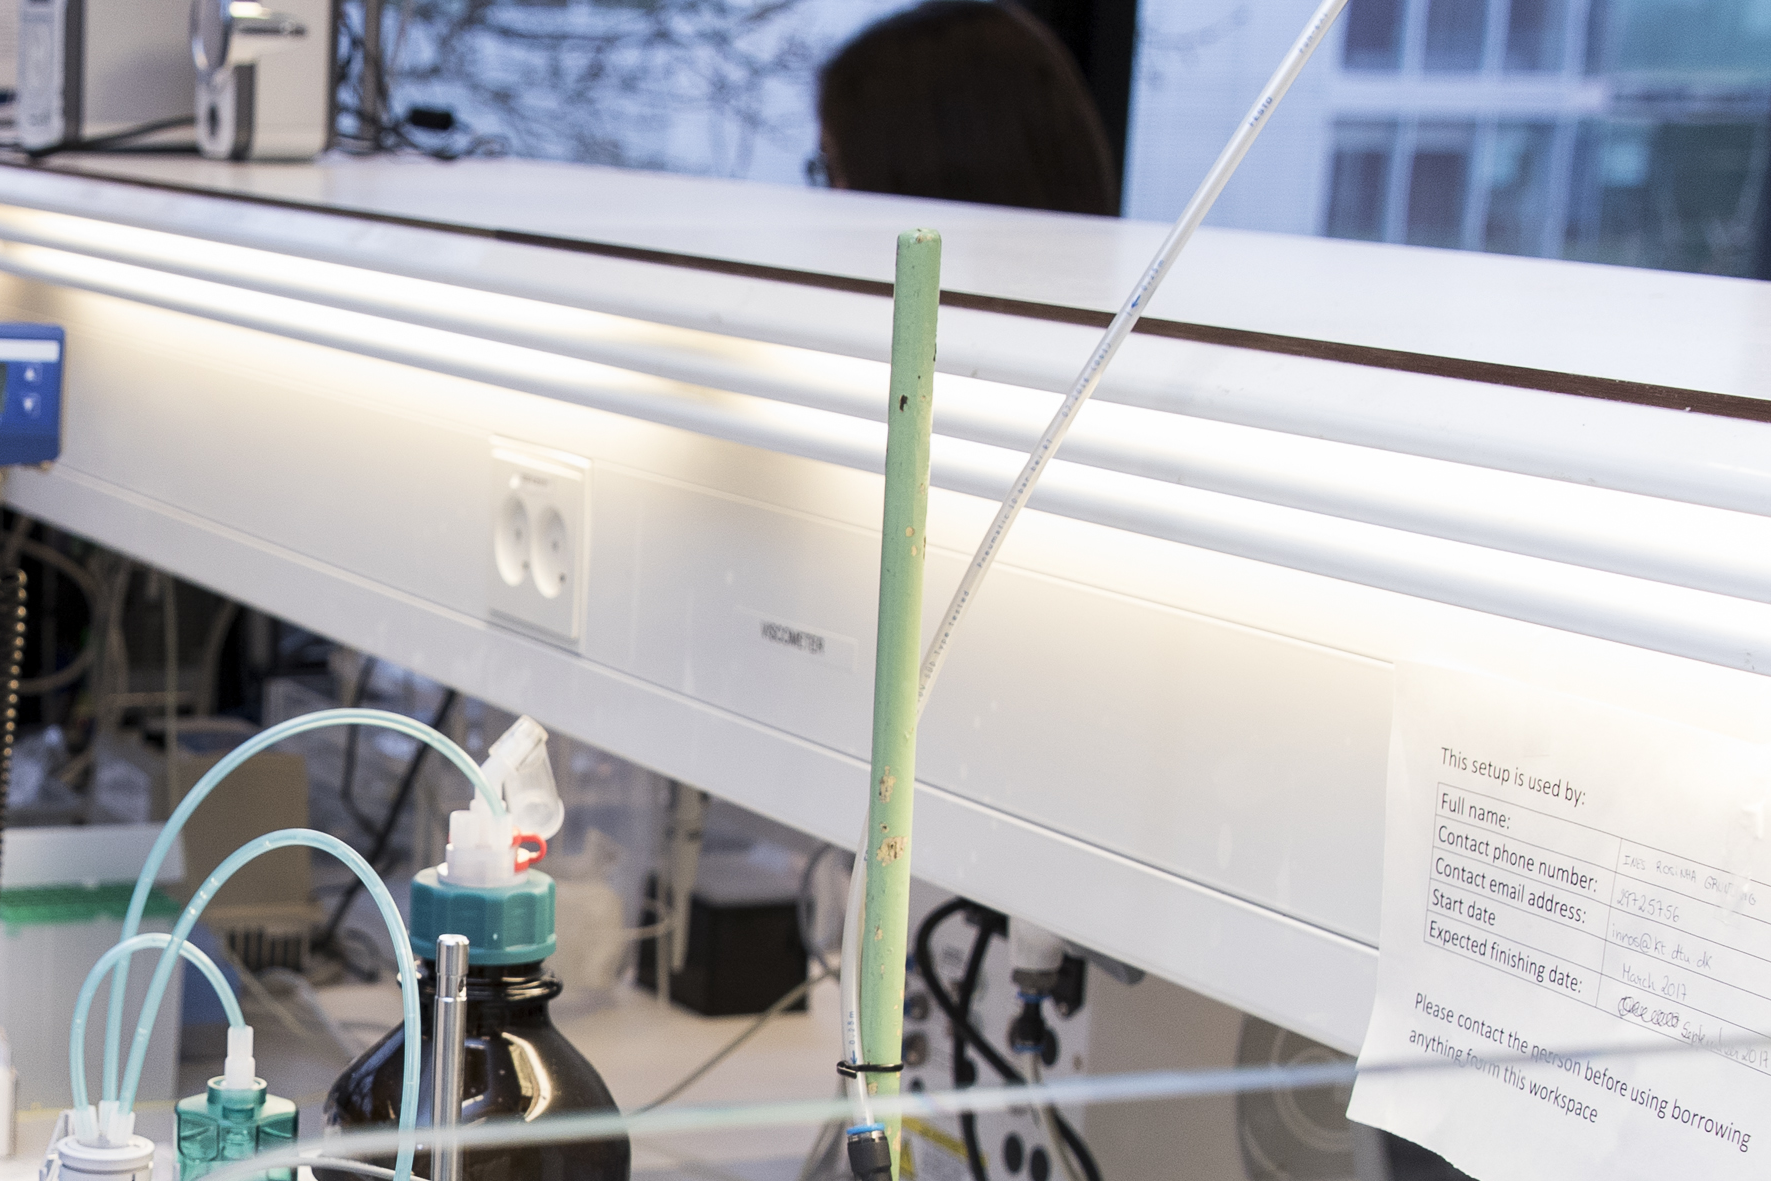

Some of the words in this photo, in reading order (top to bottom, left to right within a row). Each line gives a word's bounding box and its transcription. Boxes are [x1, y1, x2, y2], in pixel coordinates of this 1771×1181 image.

[1247, 95, 1274, 128] FESTO
[933, 631, 951, 655] Type
[947, 589, 971, 627] tested
[976, 512, 1010, 569] Pneumatic
[1441, 747, 1468, 771] This
[1471, 760, 1510, 786] setup
[1514, 767, 1524, 787] is
[1528, 775, 1561, 798] used
[1565, 781, 1586, 808] by:
[1441, 793, 1465, 816] Full
[1468, 804, 1511, 830] name:
[1435, 857, 1486, 889] Contact
[1489, 877, 1525, 903] email
[1528, 891, 1586, 924] address:
[1438, 825, 1490, 857] Contact
[1493, 844, 1535, 872] phone
[1538, 861, 1598, 893] number:
[1432, 888, 1464, 915] Start
[1467, 901, 1496, 926] date
[1429, 920, 1488, 956] Expected
[1490, 942, 1546, 983] finishing
[1548, 965, 1583, 993] date:
[1622, 963, 1656, 992] March
[1661, 975, 1687, 1000] 2017
[1409, 1029, 1463, 1068] anything
[1503, 1066, 1526, 1091] this
[1529, 1081, 1598, 1123] workspace
[1414, 992, 1455, 1024] Please
[1457, 1013, 1505, 1044] contact
[1507, 1031, 1529, 1054] the
[1530, 1044, 1581, 1076] person
[1584, 1060, 1628, 1097] before
[1630, 1086, 1669, 1119] using
[1671, 1098, 1752, 1153] borrowing
[1741, 1049, 1769, 1069] 2017
